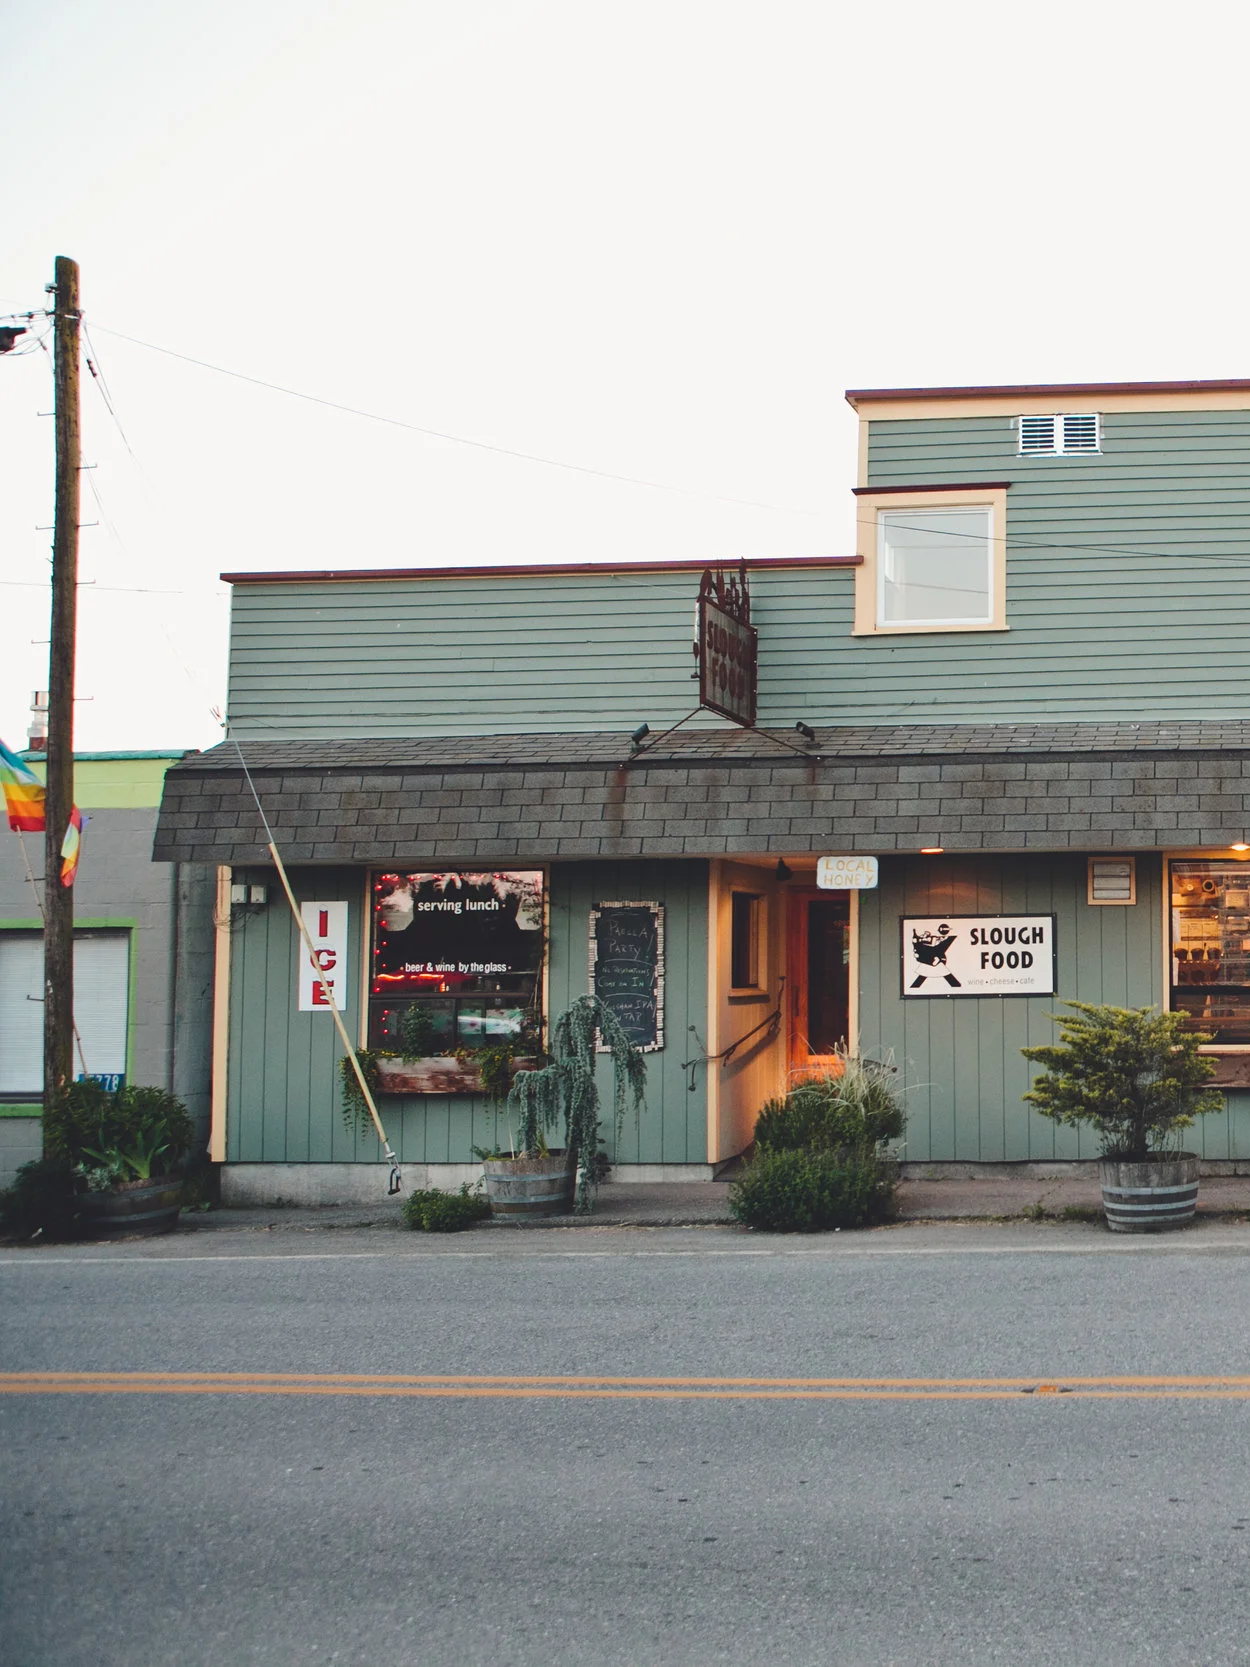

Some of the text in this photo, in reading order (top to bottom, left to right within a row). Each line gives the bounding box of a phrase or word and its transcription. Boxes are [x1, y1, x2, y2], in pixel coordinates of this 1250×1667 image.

[825, 859, 874, 873] LOCAL
[824, 873, 874, 887] HONEY
[417, 898, 499, 914] serving lunch
[970, 926, 1044, 946] SLOUGH
[310, 909, 337, 1006] ICE
[980, 950, 1034, 970] FOOD
[405, 962, 424, 972] beer
[426, 962, 434, 972] &
[435, 962, 456, 972] wine
[458, 962, 469, 974] by
[967, 976, 1035, 986] wine cheese cafe
[88, 1074, 120, 1092] 778
